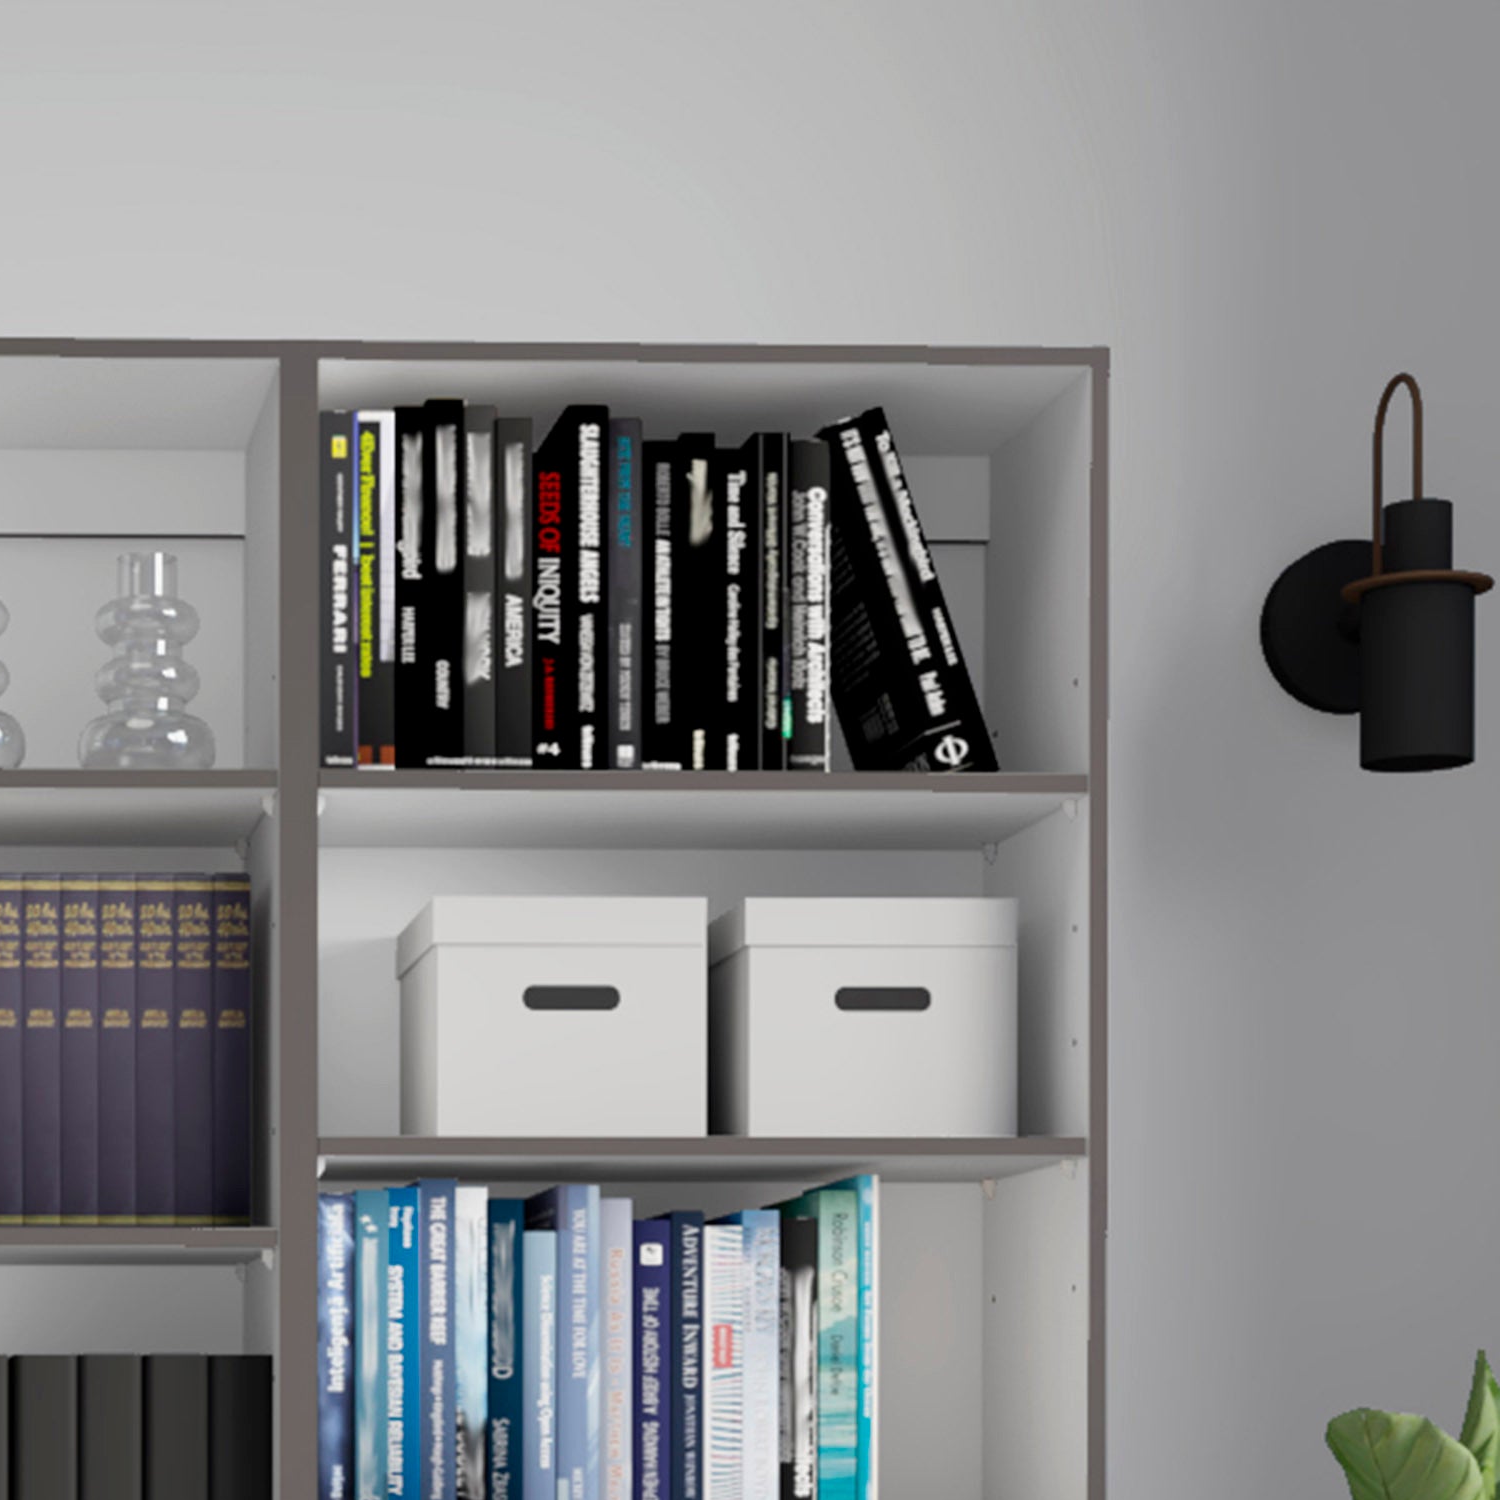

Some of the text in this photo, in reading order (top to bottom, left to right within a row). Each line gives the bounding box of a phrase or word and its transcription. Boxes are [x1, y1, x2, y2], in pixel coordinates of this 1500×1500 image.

[727, 470, 746, 503] Time
[791, 490, 807, 524] John
[578, 423, 600, 604] SLAUGHTERHOUSE ANGELS
[533, 472, 560, 645] SEEDS OF INIQUITY
[727, 530, 746, 576] Silence
[332, 545, 347, 654] FERRARI
[806, 487, 826, 724] Conversations with Architects
[505, 594, 523, 668] AMERICA
[429, 1196, 448, 1221] THE
[571, 1208, 588, 1234] YOU
[429, 1222, 448, 1262] GREAT
[830, 1213, 848, 1312] Robinson Crusoe
[571, 1297, 588, 1323] TIME
[681, 1224, 701, 1390] ADVENTURE INWARD
[429, 1317, 448, 1346] REEF
[830, 1334, 844, 1362] Daniel
[387, 1265, 404, 1496] SYSTEM AND BAYESIAN RELIABILITY
[571, 1350, 588, 1380] LOVE
